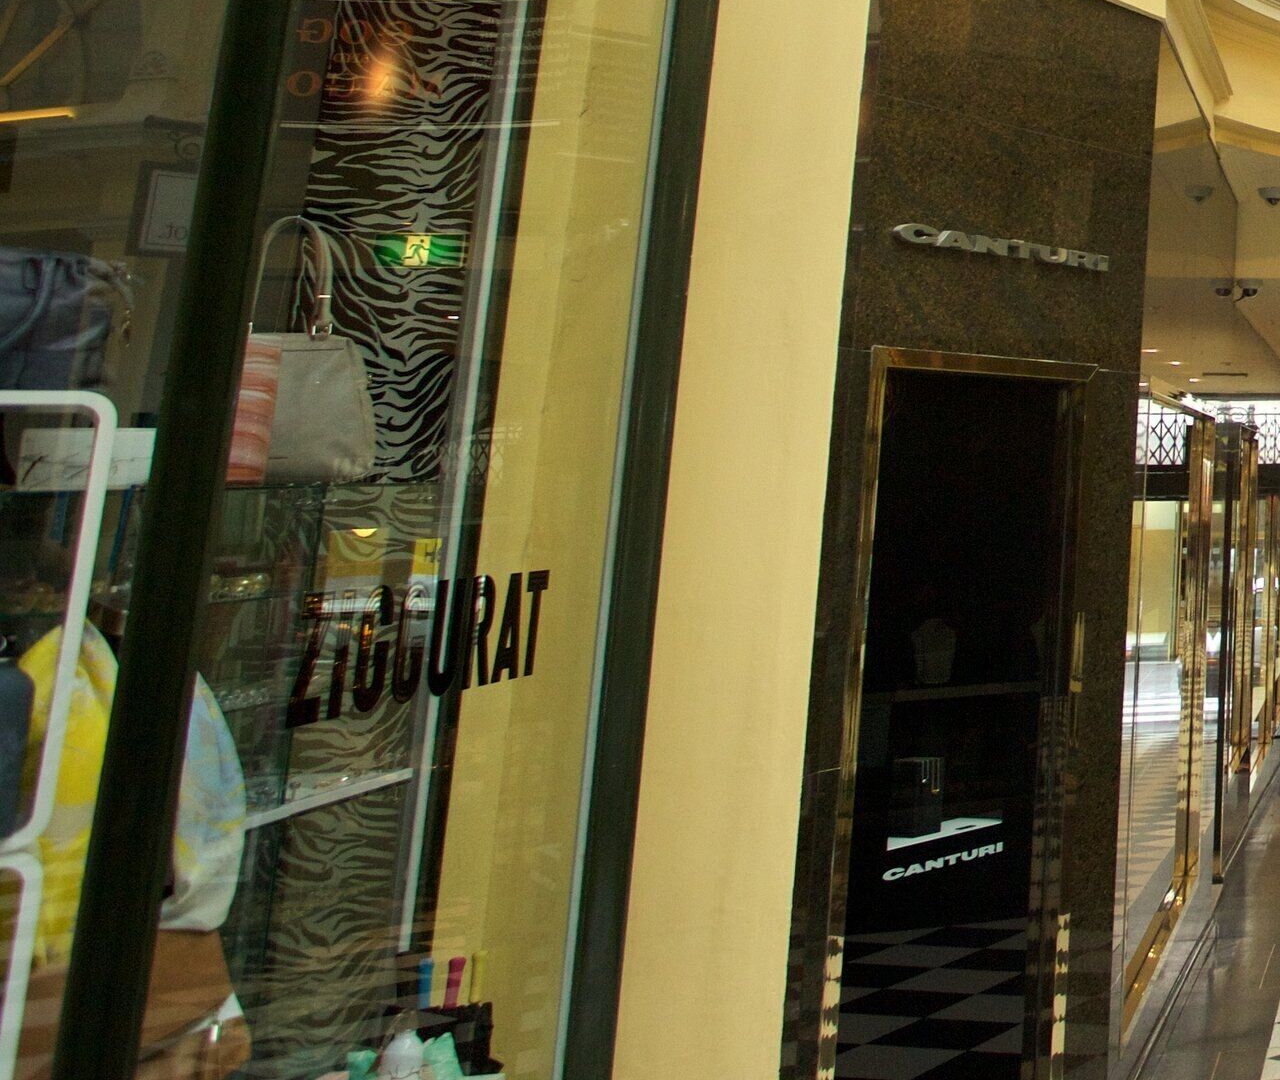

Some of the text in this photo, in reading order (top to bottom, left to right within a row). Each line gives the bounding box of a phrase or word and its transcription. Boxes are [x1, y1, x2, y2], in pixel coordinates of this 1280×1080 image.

[892, 222, 1110, 271] CANTURI
[286, 570, 549, 728] ZIGGURAT
[882, 842, 1004, 881] CANTURI
